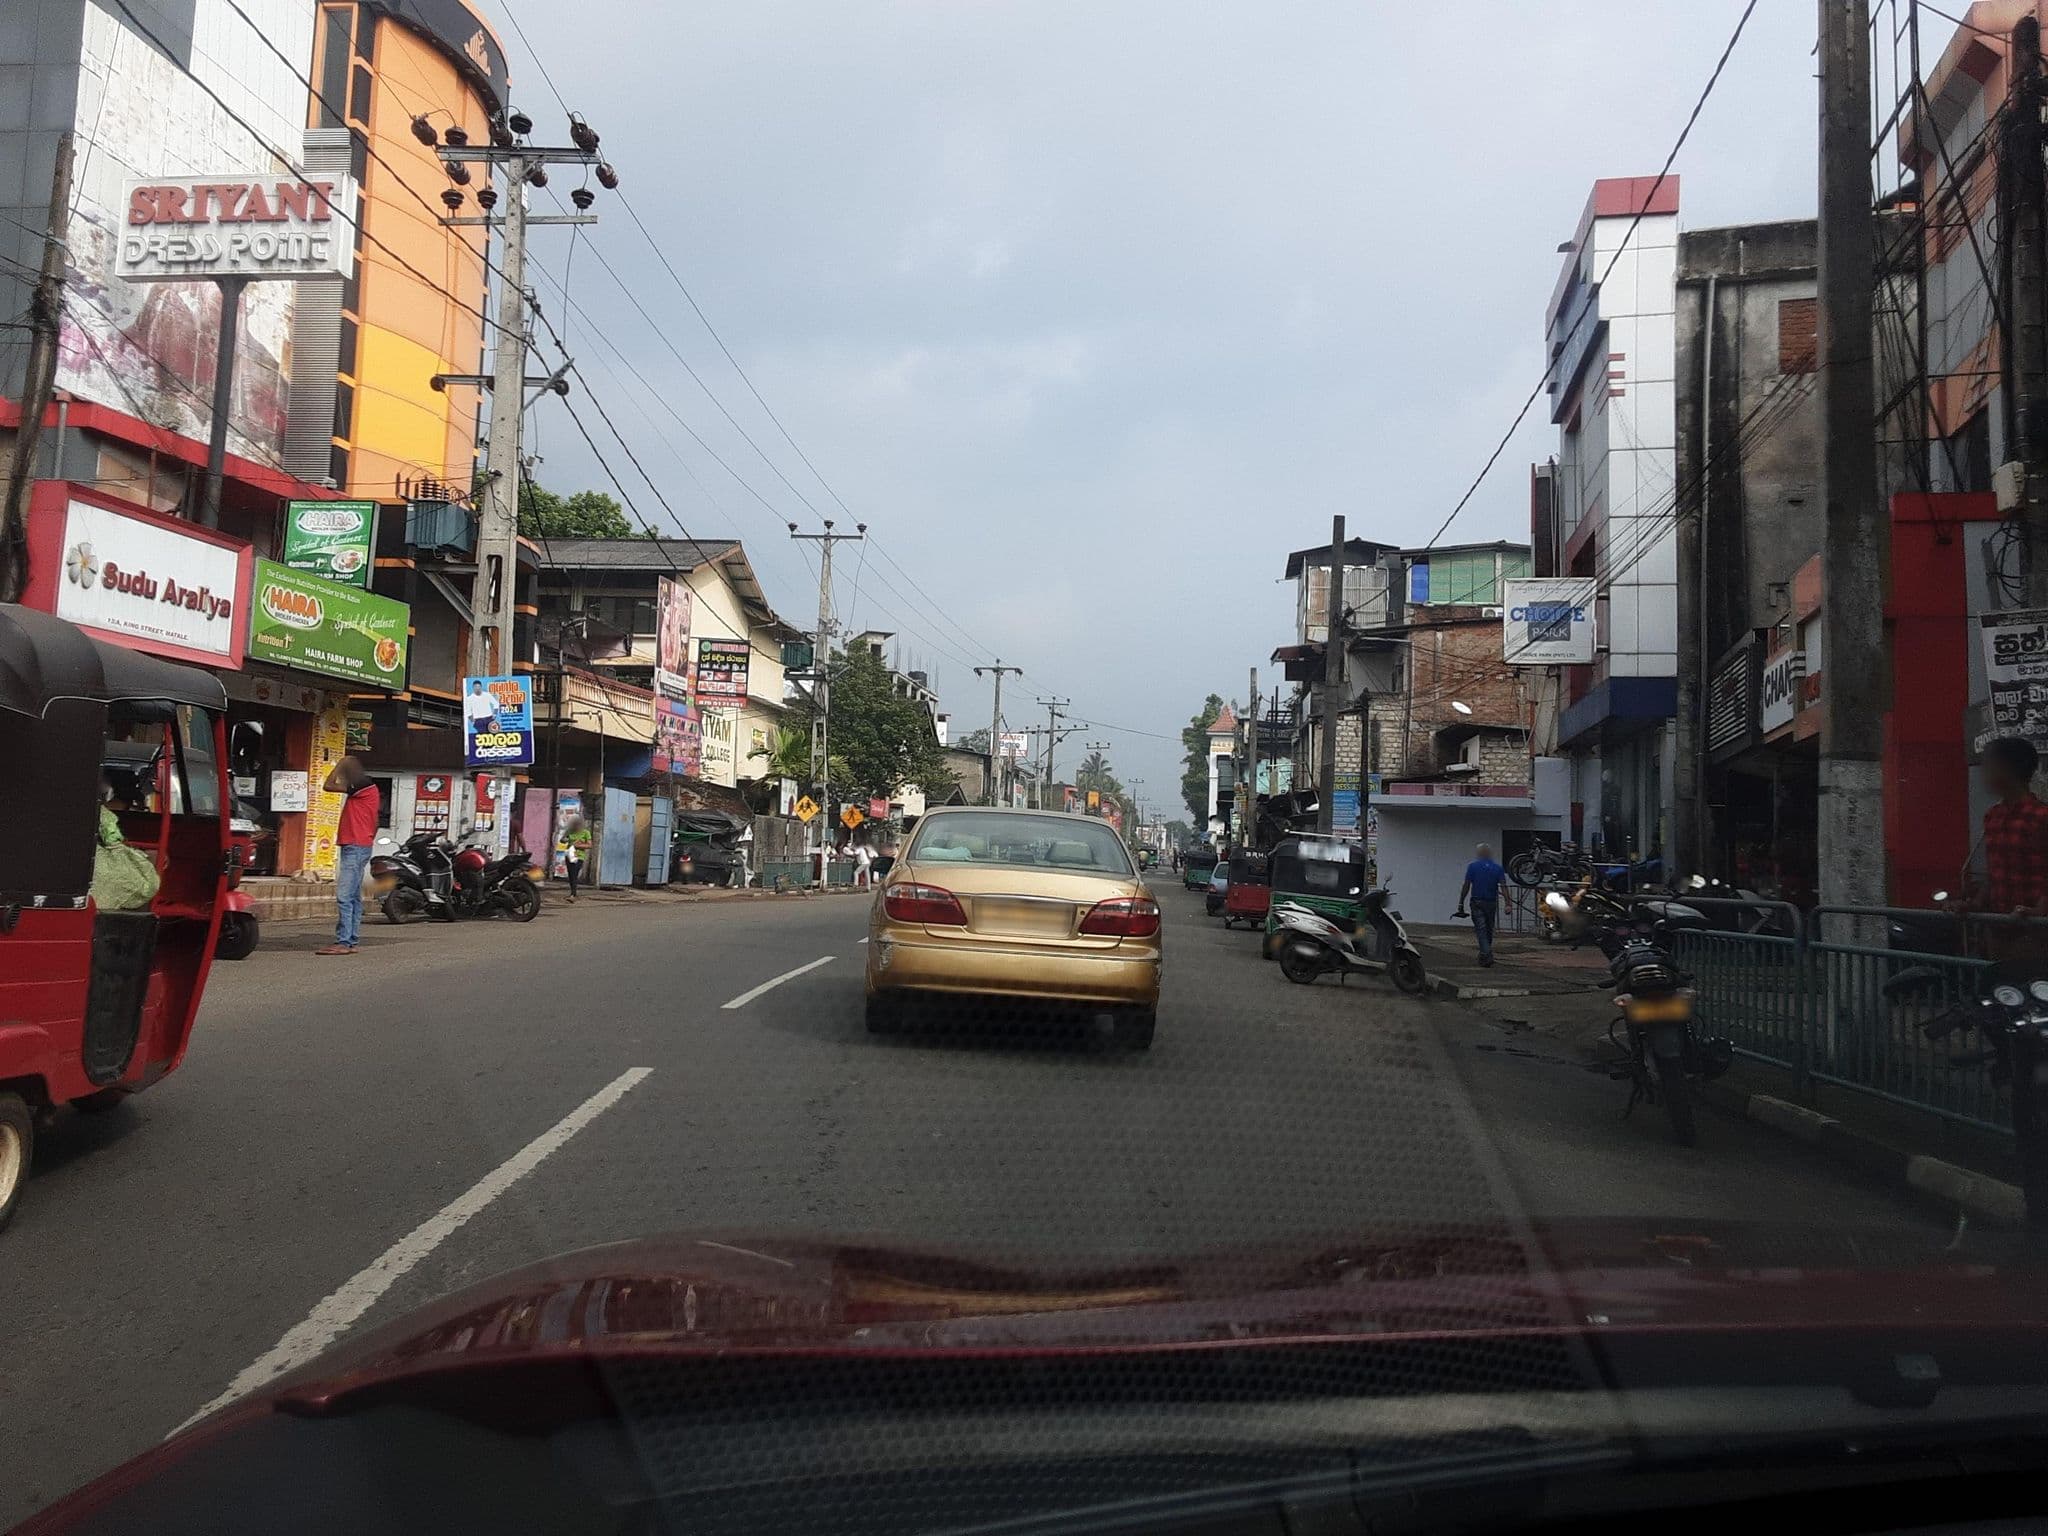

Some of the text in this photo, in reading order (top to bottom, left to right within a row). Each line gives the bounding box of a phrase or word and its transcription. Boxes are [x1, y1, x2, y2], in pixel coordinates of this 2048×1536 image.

[128, 182, 334, 224] SRIYANI
[126, 234, 222, 264] DRESS
[306, 512, 354, 526] HAIRA
[102, 562, 158, 600] Sudu
[269, 586, 318, 620] HAIRA
[305, 648, 327, 661] HAIRA
[327, 652, 345, 664] FARM
[345, 656, 364, 669] SHOP
[501, 705, 518, 713] 2024
[475, 733, 521, 747] නාලක
